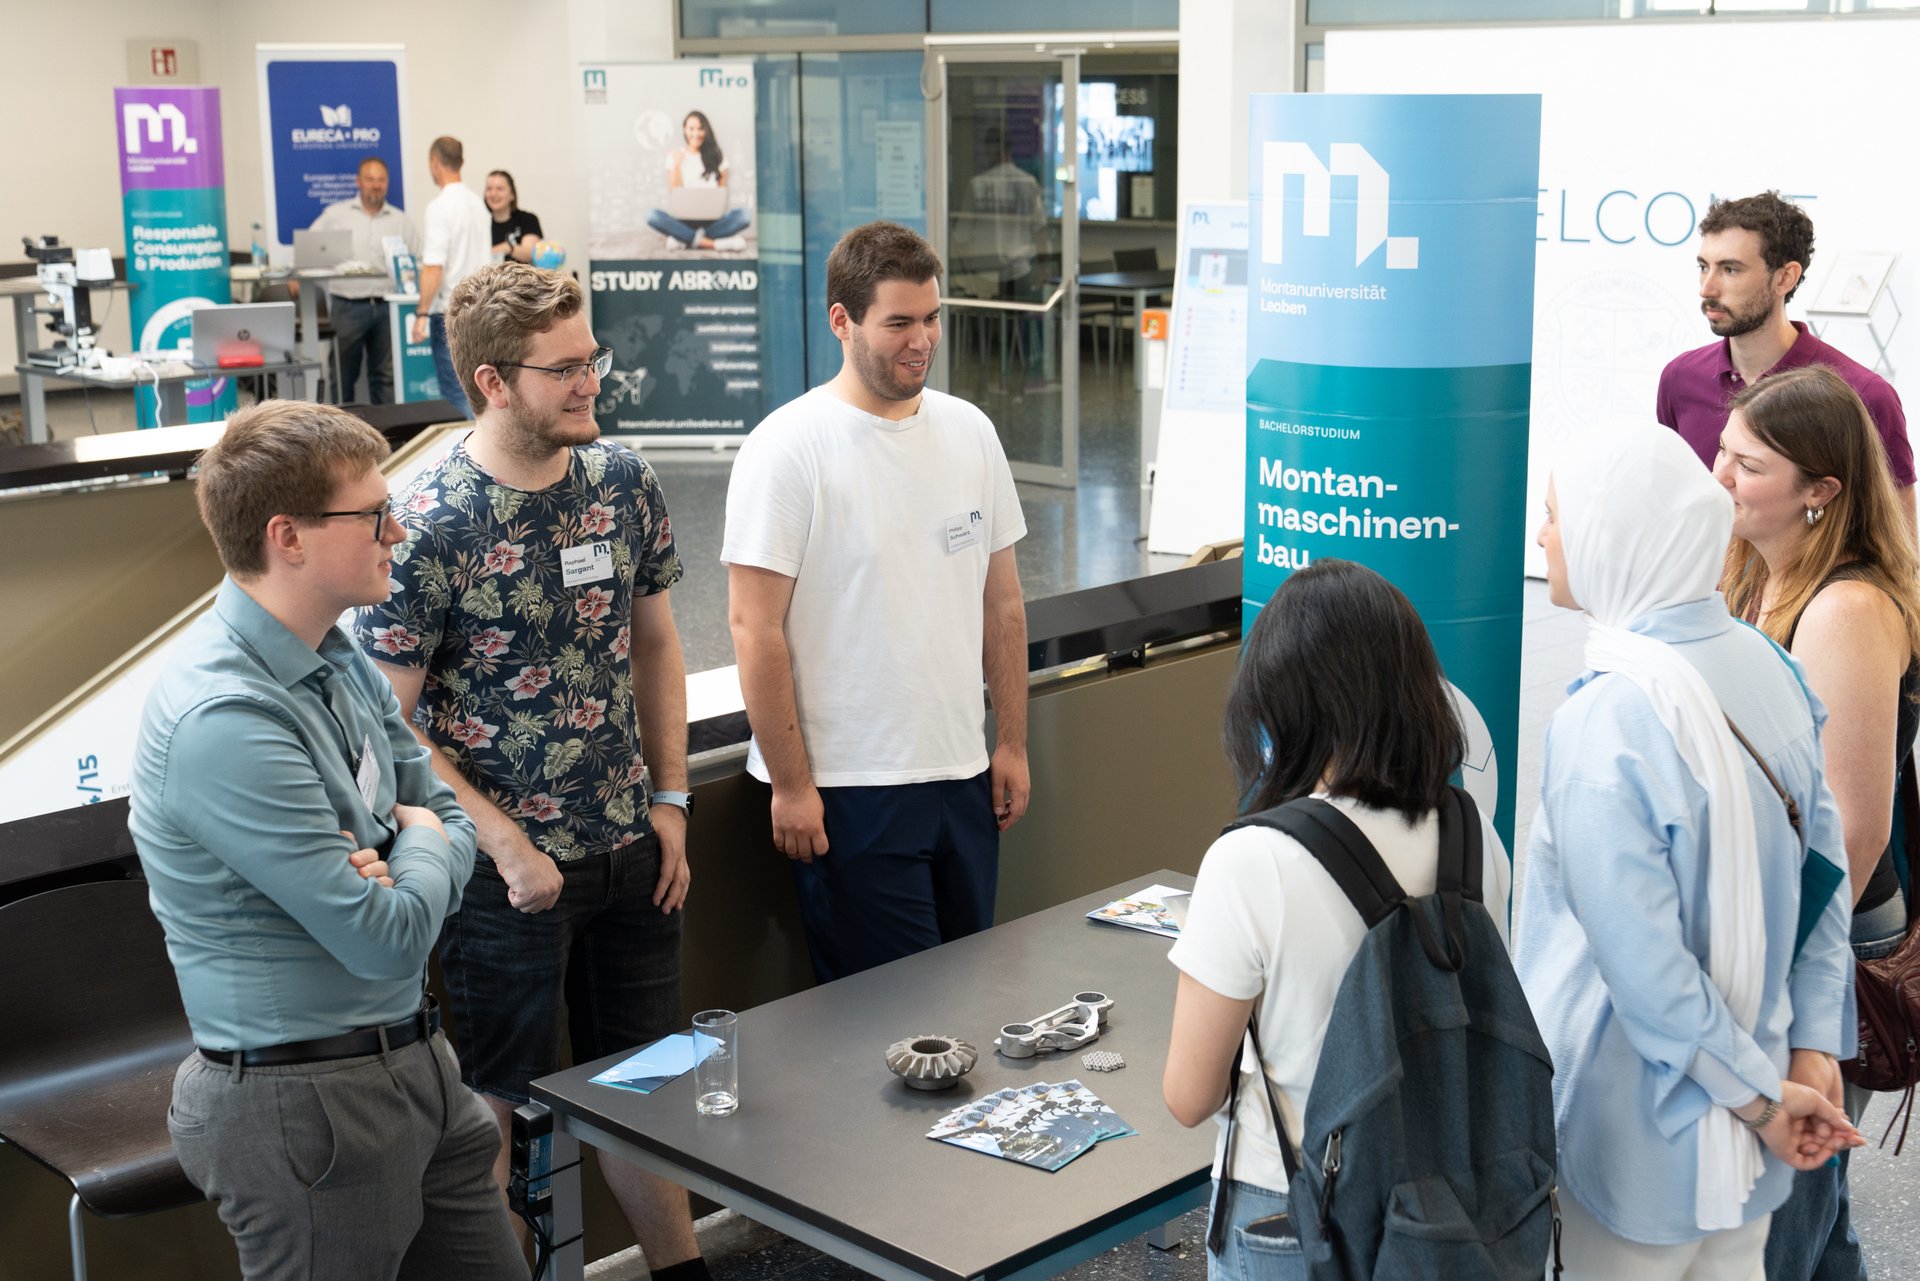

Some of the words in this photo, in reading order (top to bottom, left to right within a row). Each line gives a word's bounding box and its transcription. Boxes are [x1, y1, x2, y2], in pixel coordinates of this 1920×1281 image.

[352, 128, 380, 142] PRO
[133, 224, 217, 242] Responsible
[149, 255, 222, 271] Production
[592, 271, 664, 291] STUDY
[1261, 278, 1387, 300] Montanuniversität
[1261, 298, 1307, 316] Leoben
[1259, 418, 1361, 440] BACHELORSTUDIUM
[1259, 456, 1398, 498] Montan-
[1258, 501, 1460, 539] maschinen-
[1257, 534, 1312, 570] bau
